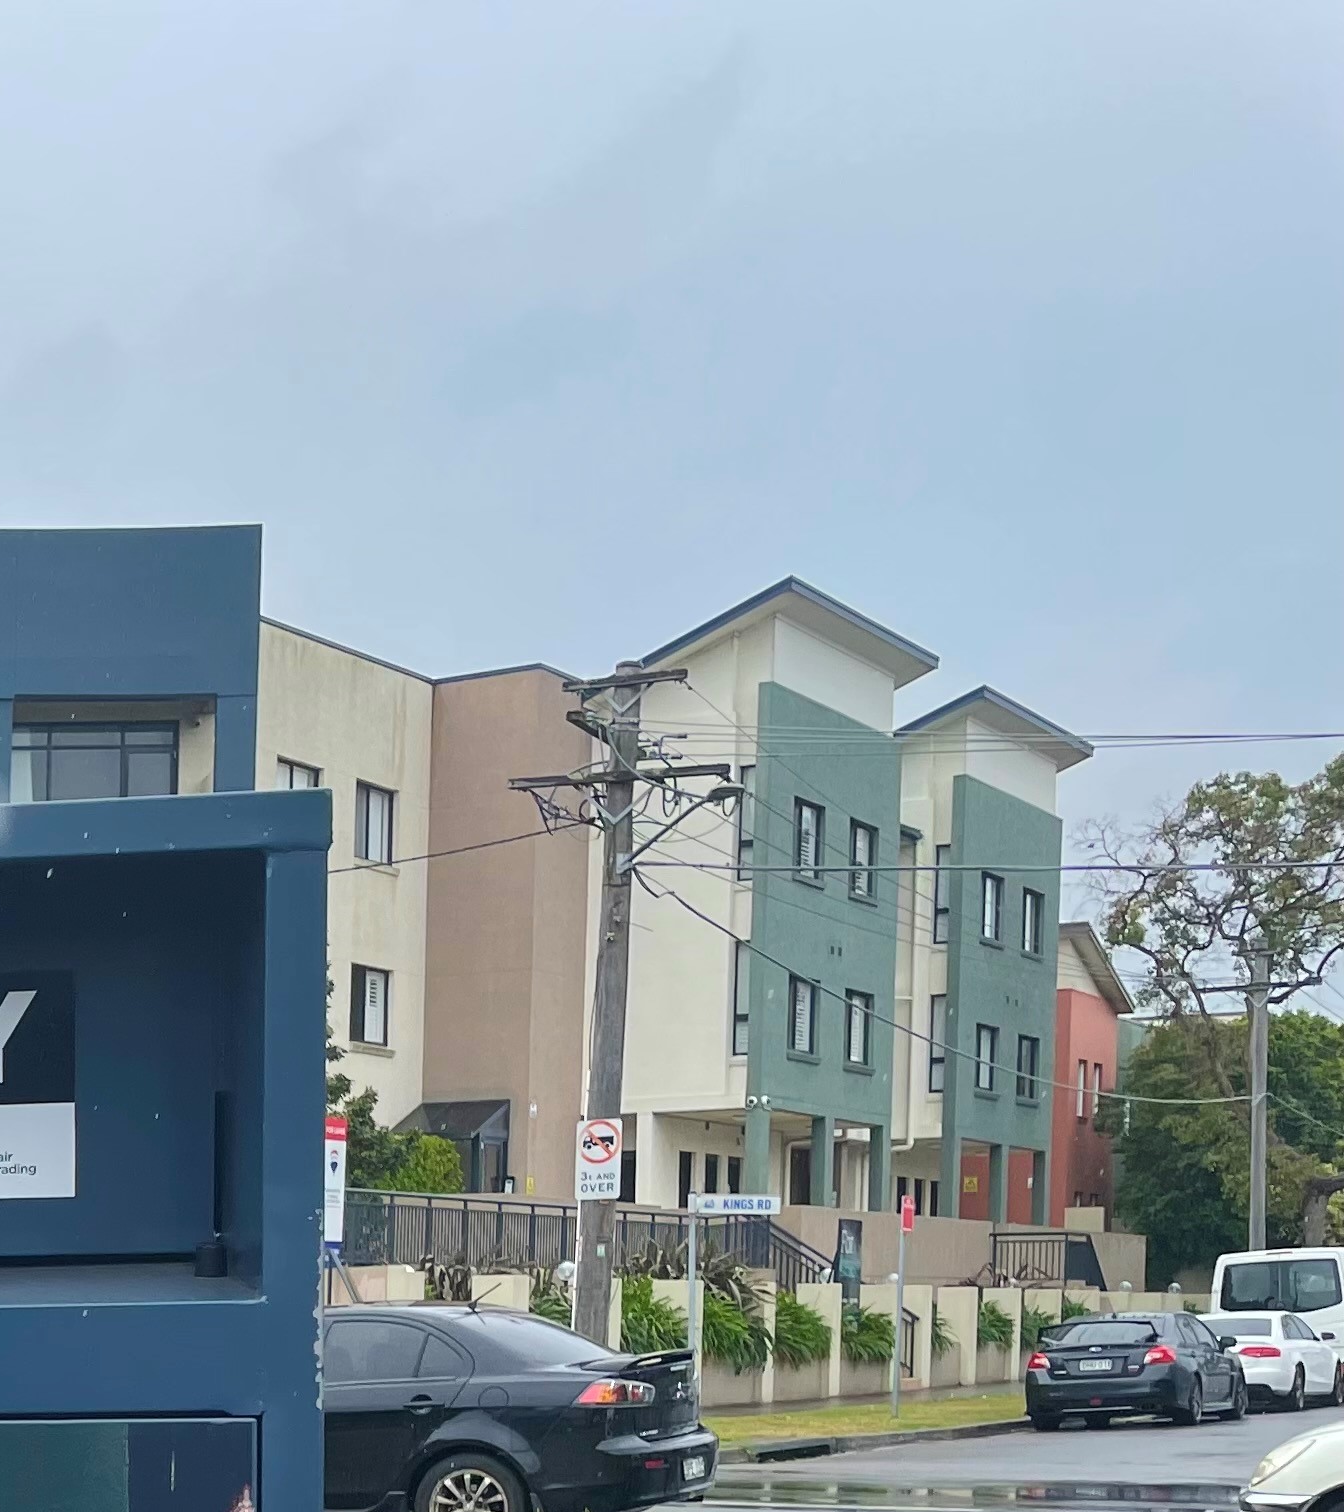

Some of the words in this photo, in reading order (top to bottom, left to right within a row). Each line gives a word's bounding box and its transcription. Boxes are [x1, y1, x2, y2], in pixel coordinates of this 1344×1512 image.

[596, 1172, 616, 1180] AND
[580, 1183, 614, 1193] OVER
[723, 1198, 754, 1210] KINGS
[757, 1199, 772, 1210] RD
